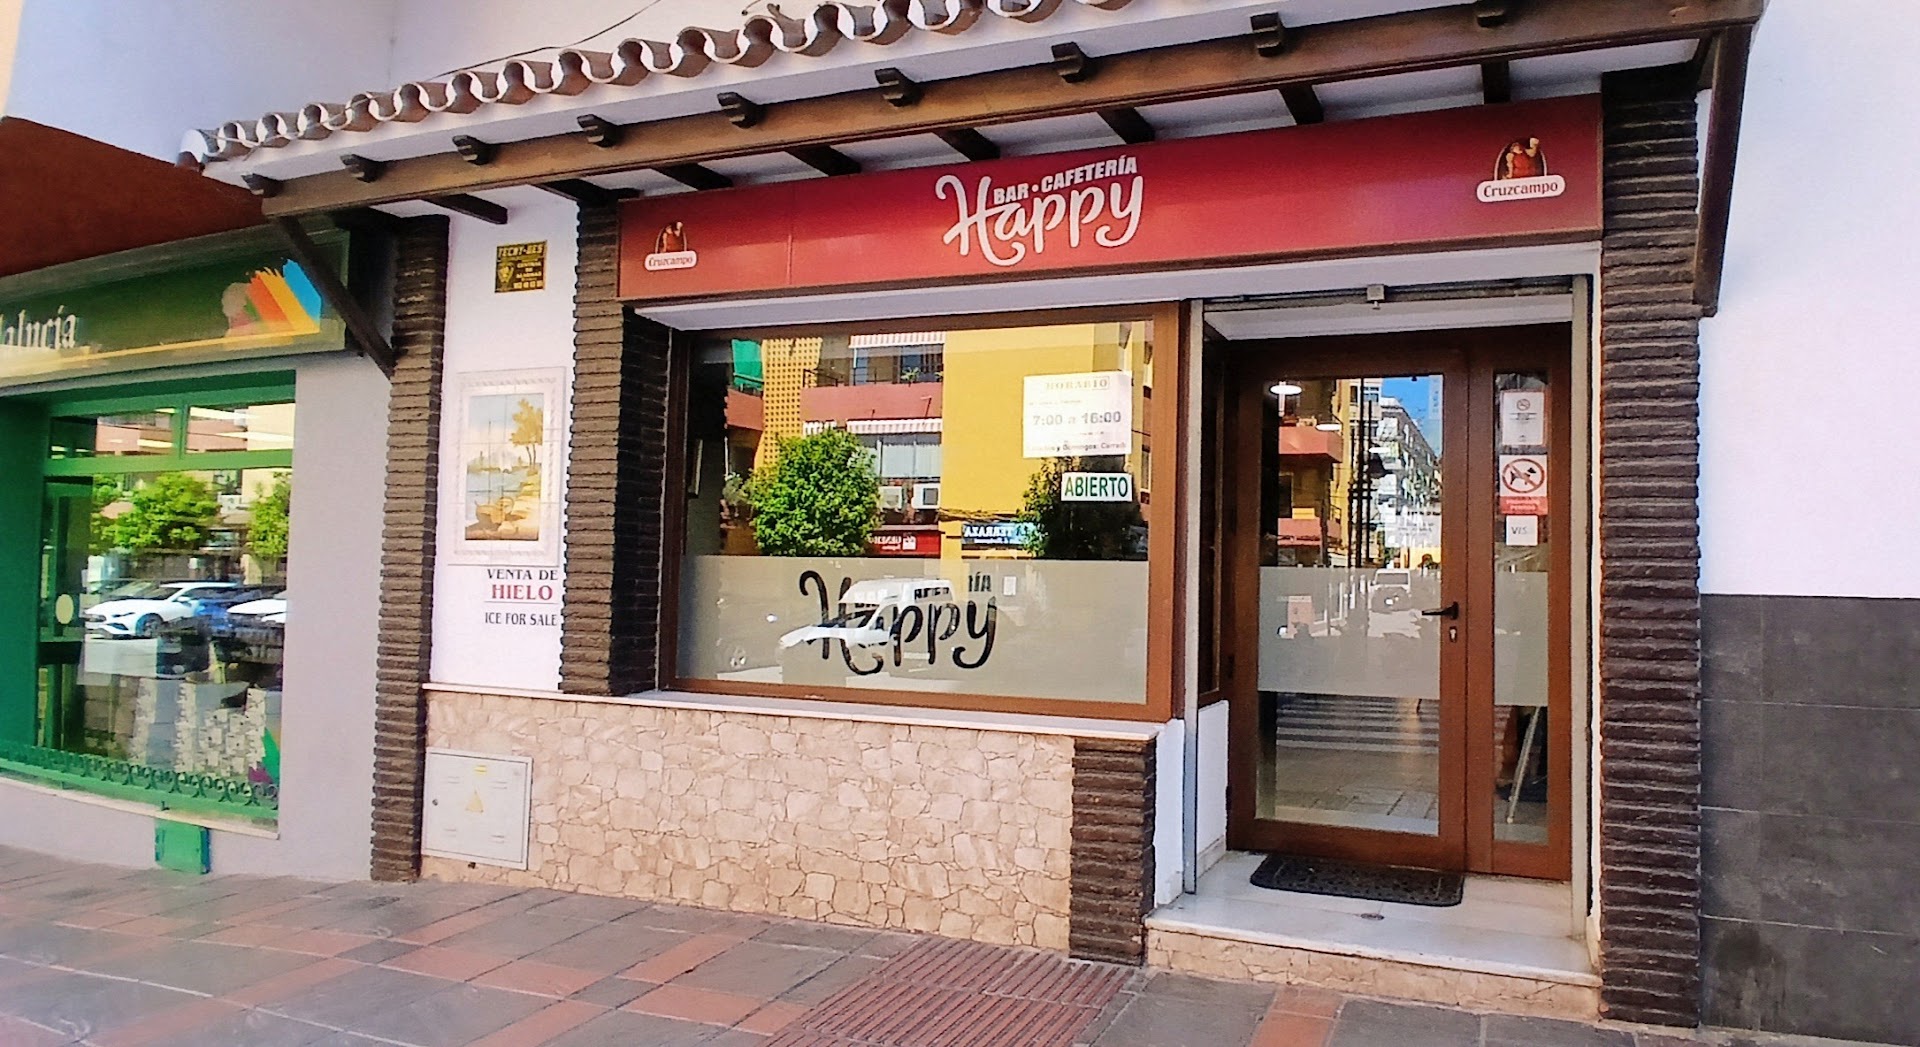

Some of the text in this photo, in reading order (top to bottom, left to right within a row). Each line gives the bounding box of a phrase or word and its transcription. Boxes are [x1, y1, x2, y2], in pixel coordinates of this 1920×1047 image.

[993, 155, 1137, 204] BAR CAFETERÍA
[1483, 182, 1558, 197] Cruzcampo
[935, 174, 1144, 267] Happy
[1081, 411, 1121, 424] 16:00
[1064, 476, 1129, 498] ABIERTO
[487, 568, 559, 581] VENTA DE
[492, 584, 553, 600] HIELO
[485, 612, 557, 626] ICE FOR SALE
